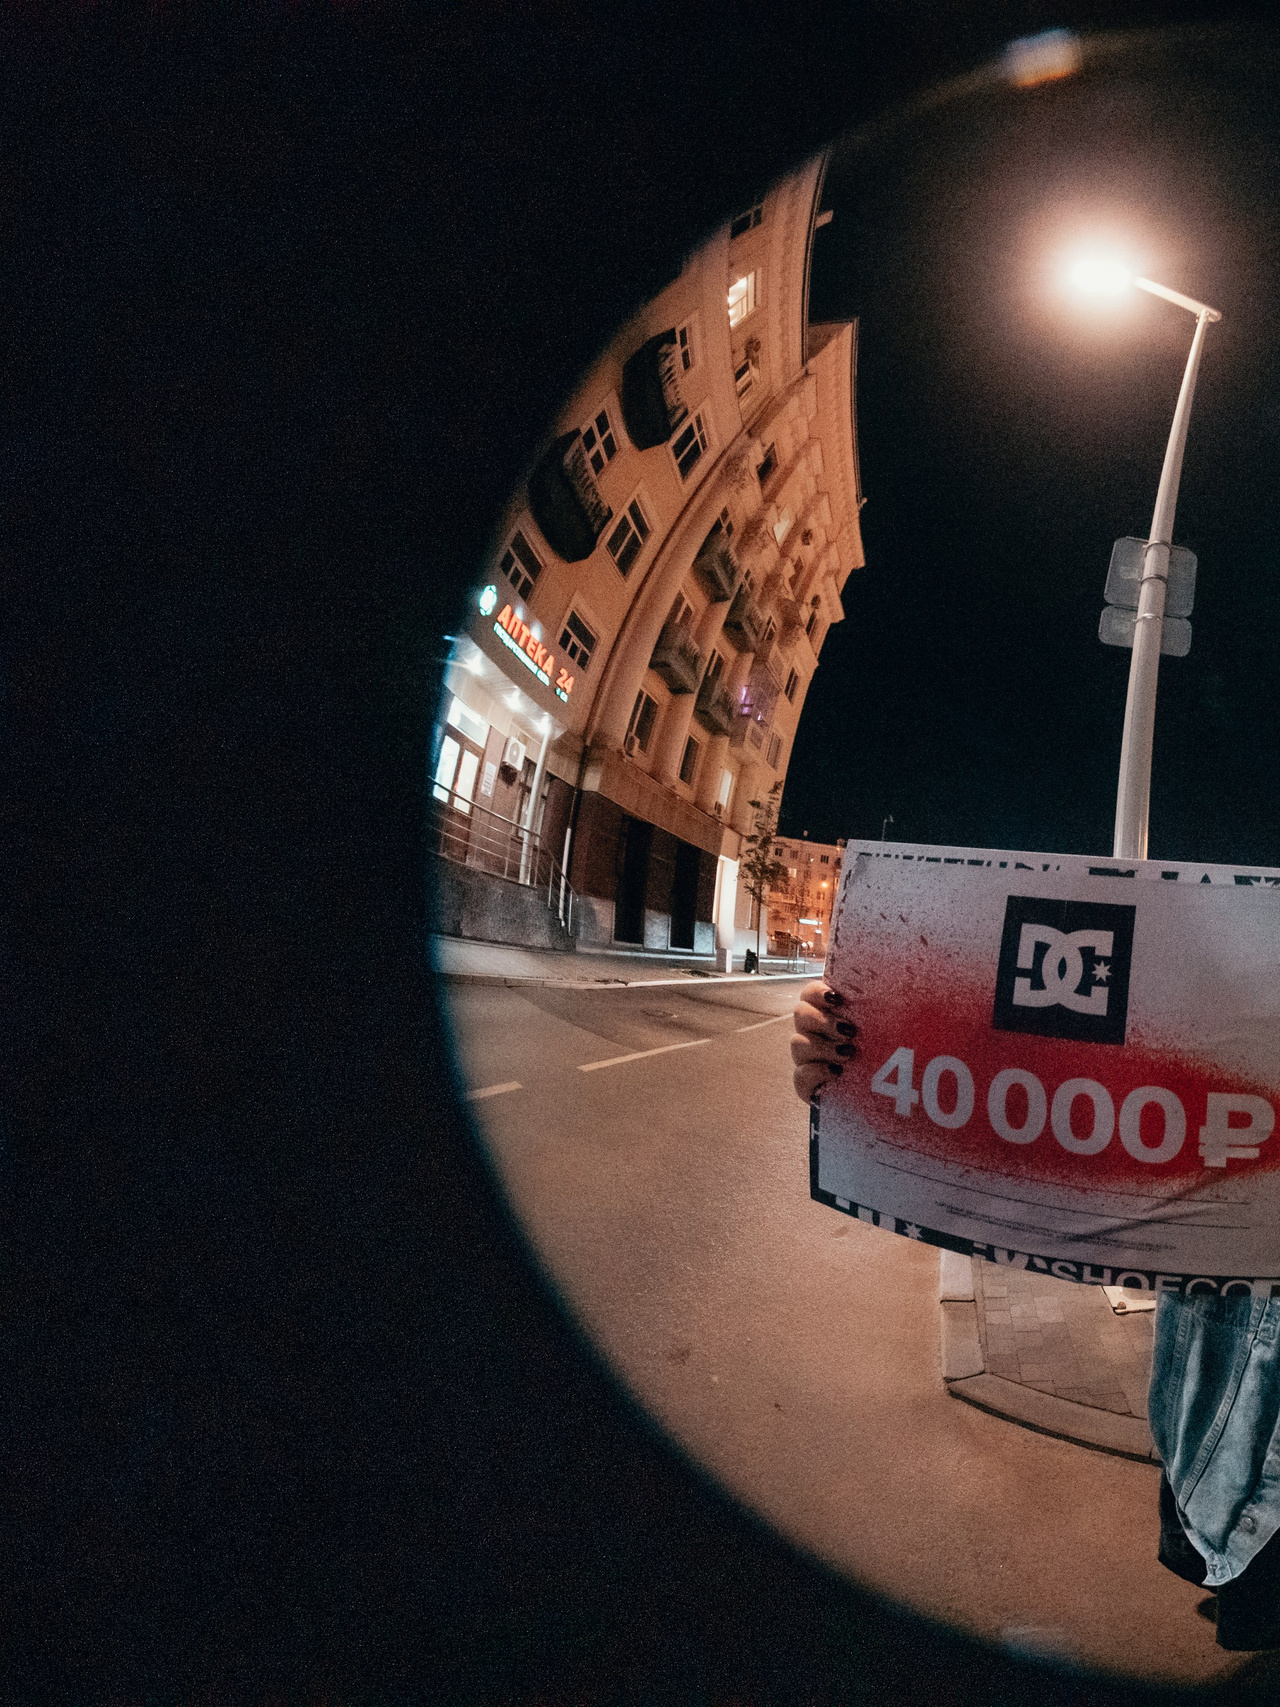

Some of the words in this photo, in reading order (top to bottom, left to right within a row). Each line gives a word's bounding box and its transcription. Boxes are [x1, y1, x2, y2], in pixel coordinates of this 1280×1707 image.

[497, 604, 555, 678] АПТЕКА
[556, 667, 575, 695] 24
[1012, 922, 1114, 1017] DC
